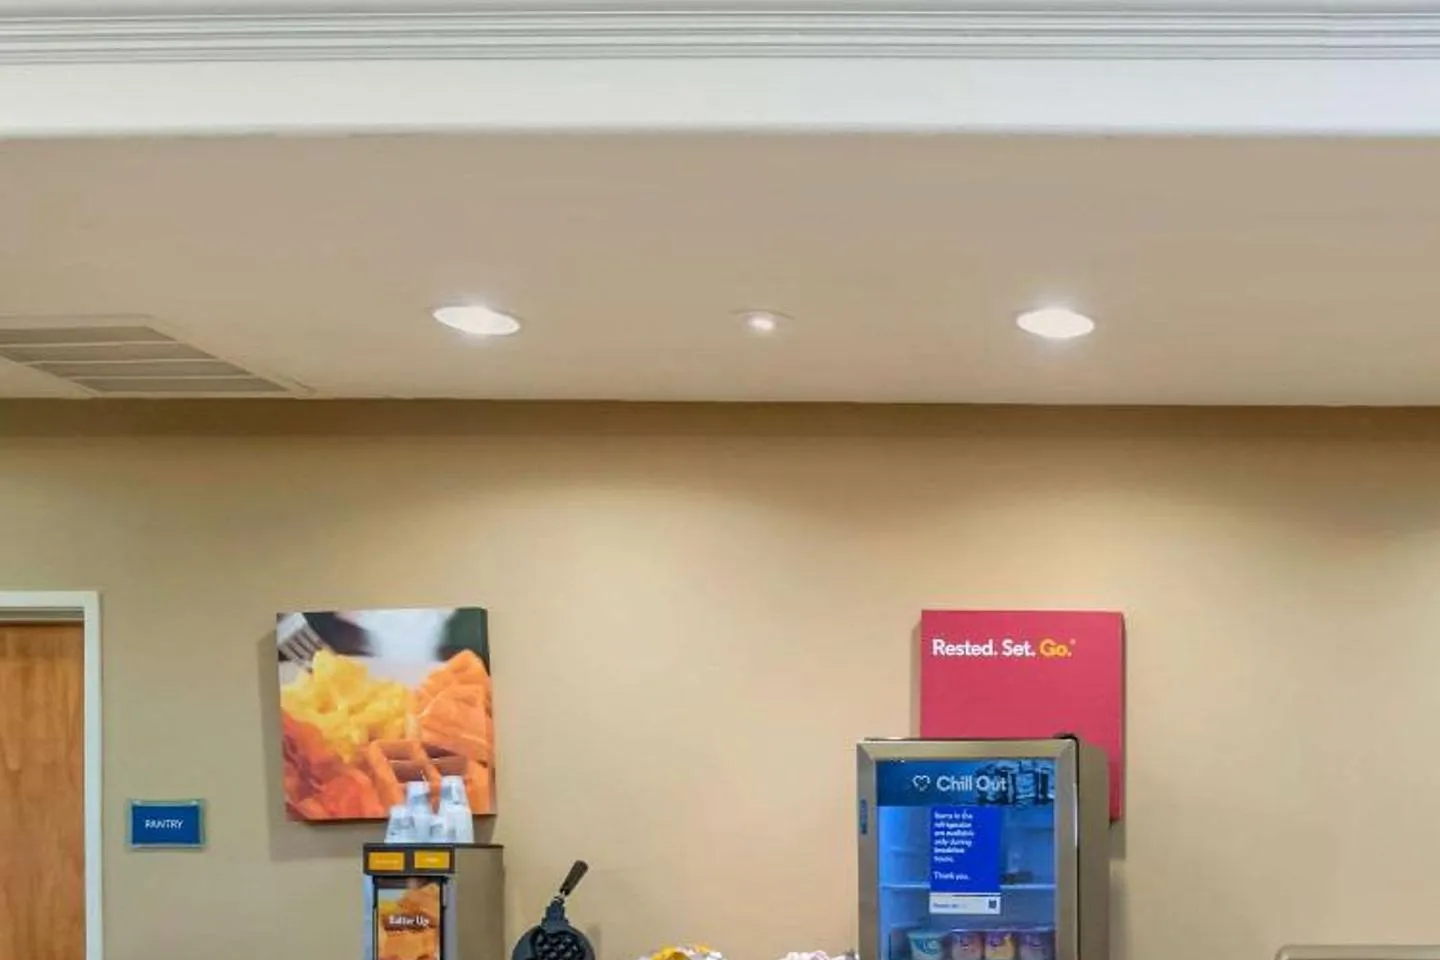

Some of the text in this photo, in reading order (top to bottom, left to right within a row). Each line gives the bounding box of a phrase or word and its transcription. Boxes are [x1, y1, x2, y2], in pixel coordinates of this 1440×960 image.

[932, 638, 998, 657] Rested.
[1002, 638, 1036, 657] Set.
[936, 774, 1008, 792] Chill Out
[144, 818, 184, 830] PANTRY
[933, 871, 955, 880] Thank
[415, 914, 430, 928] Up
